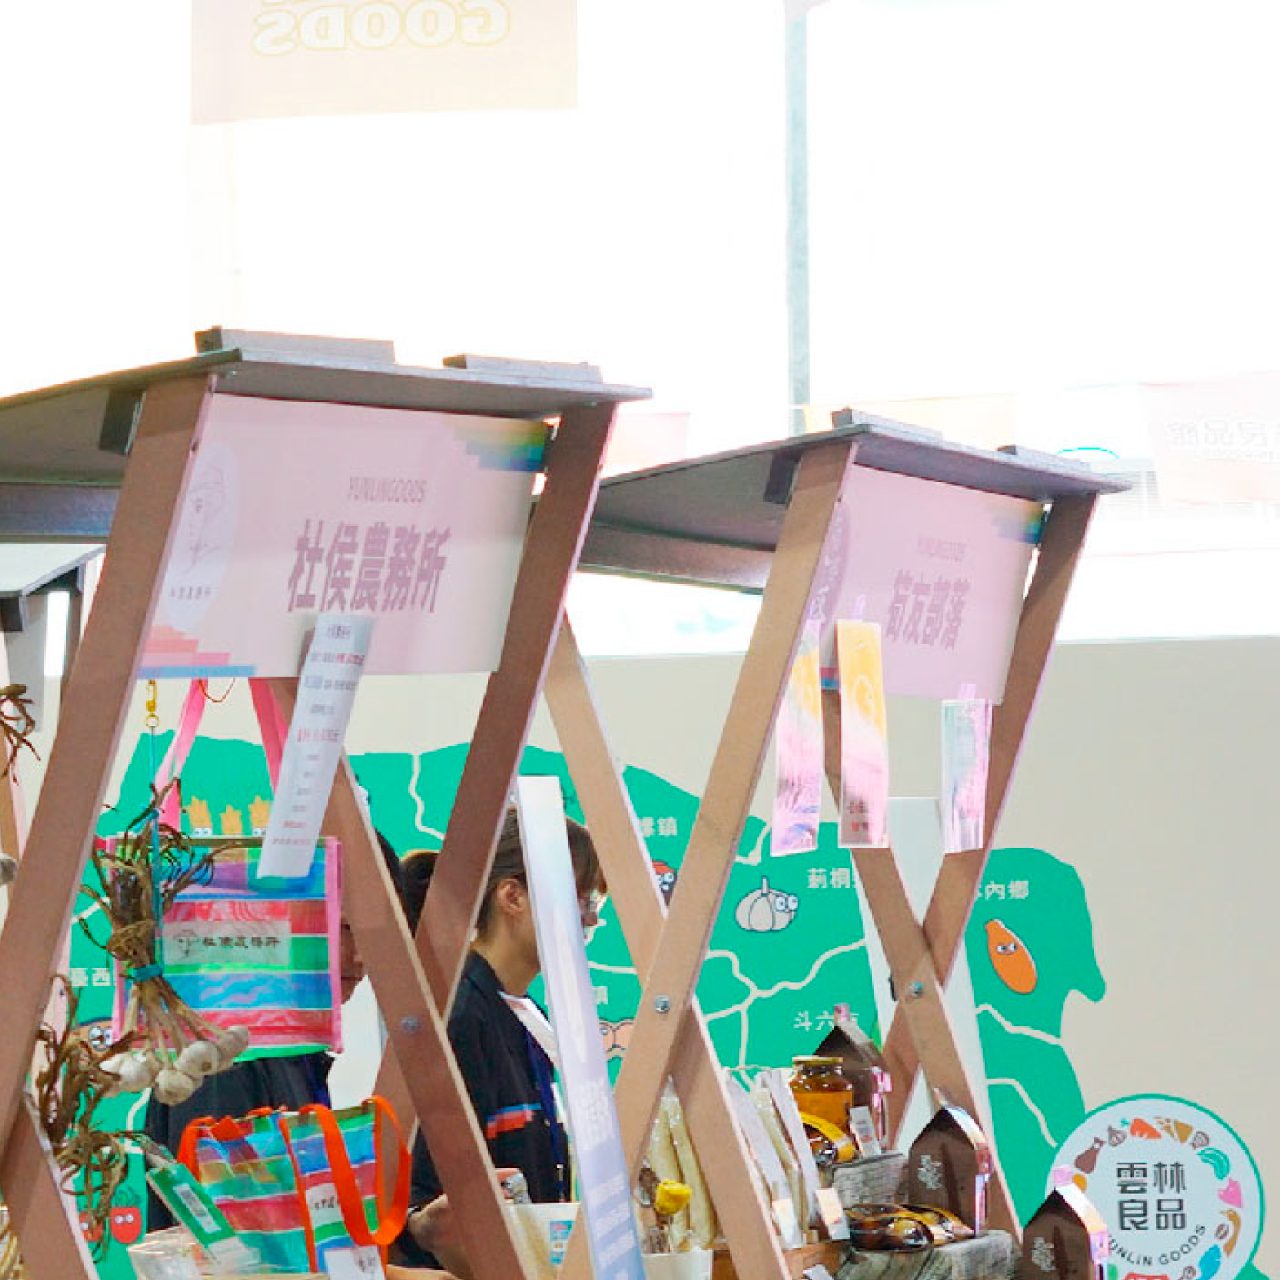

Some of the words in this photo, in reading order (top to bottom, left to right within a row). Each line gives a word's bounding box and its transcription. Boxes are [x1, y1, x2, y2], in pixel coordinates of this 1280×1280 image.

[288, 519, 452, 614] 杜侯農務所
[978, 880, 1030, 900] 內鄉
[1116, 1161, 1187, 1195] 雲林
[1117, 1198, 1187, 1231] 良品
[1107, 1233, 1153, 1267] UNLIN
[1158, 1223, 1206, 1265] GOODS
